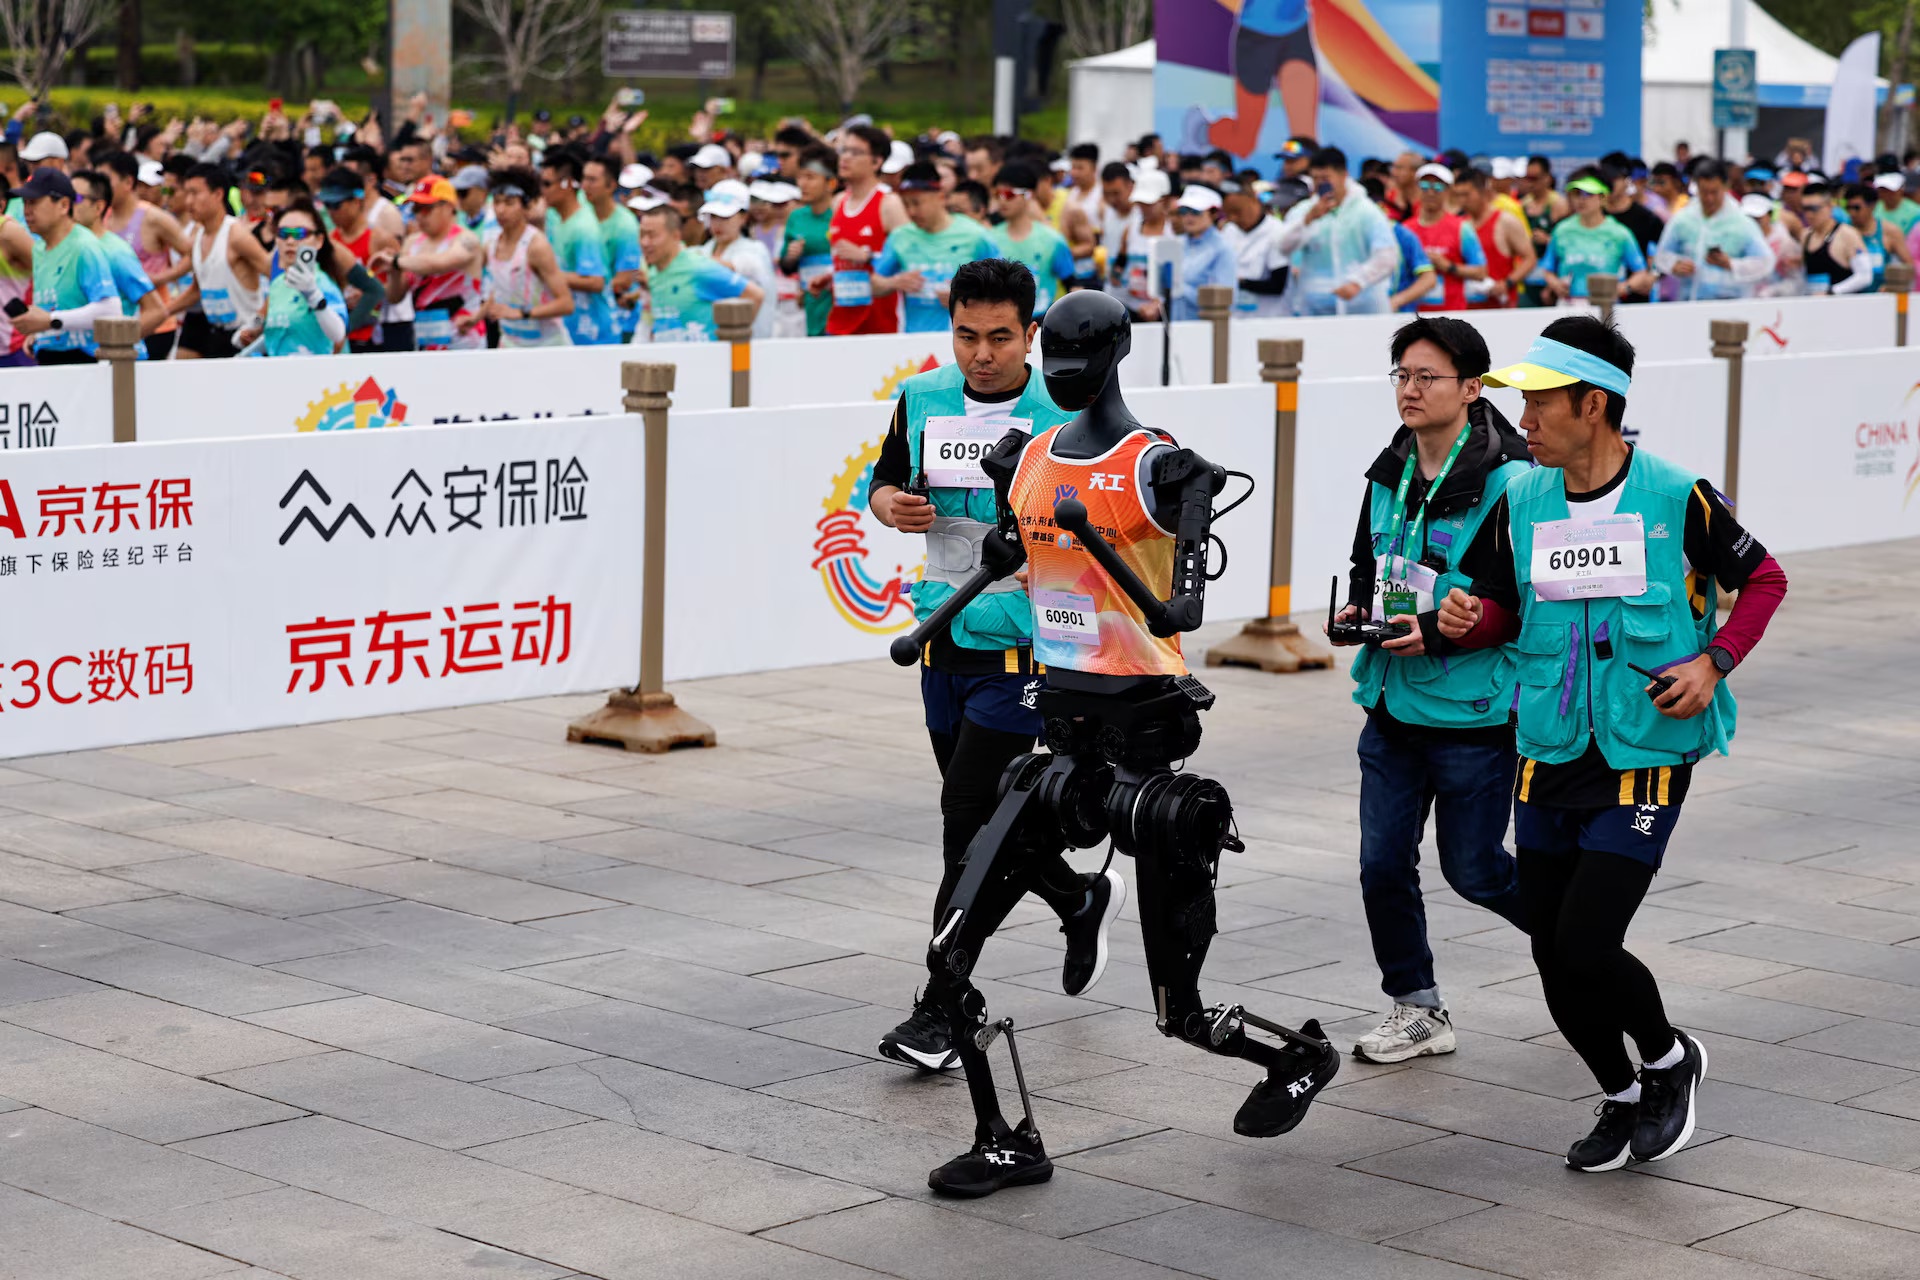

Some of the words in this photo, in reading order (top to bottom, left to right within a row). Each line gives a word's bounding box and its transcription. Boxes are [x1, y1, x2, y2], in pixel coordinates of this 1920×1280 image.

[1855, 421, 1909, 449] CHINA
[940, 442, 994, 461] 6090
[1088, 472, 1126, 492] 天工
[385, 456, 589, 537] 众安保险
[0, 542, 193, 577] 旗下保险经纪平台
[1549, 545, 1622, 571] 60901
[1046, 609, 1085, 626] 60901
[286, 595, 572, 693] 京东运动
[0, 642, 194, 714] 3C数码
[1286, 1072, 1315, 1098] 天工
[985, 1149, 1016, 1166] 天工
